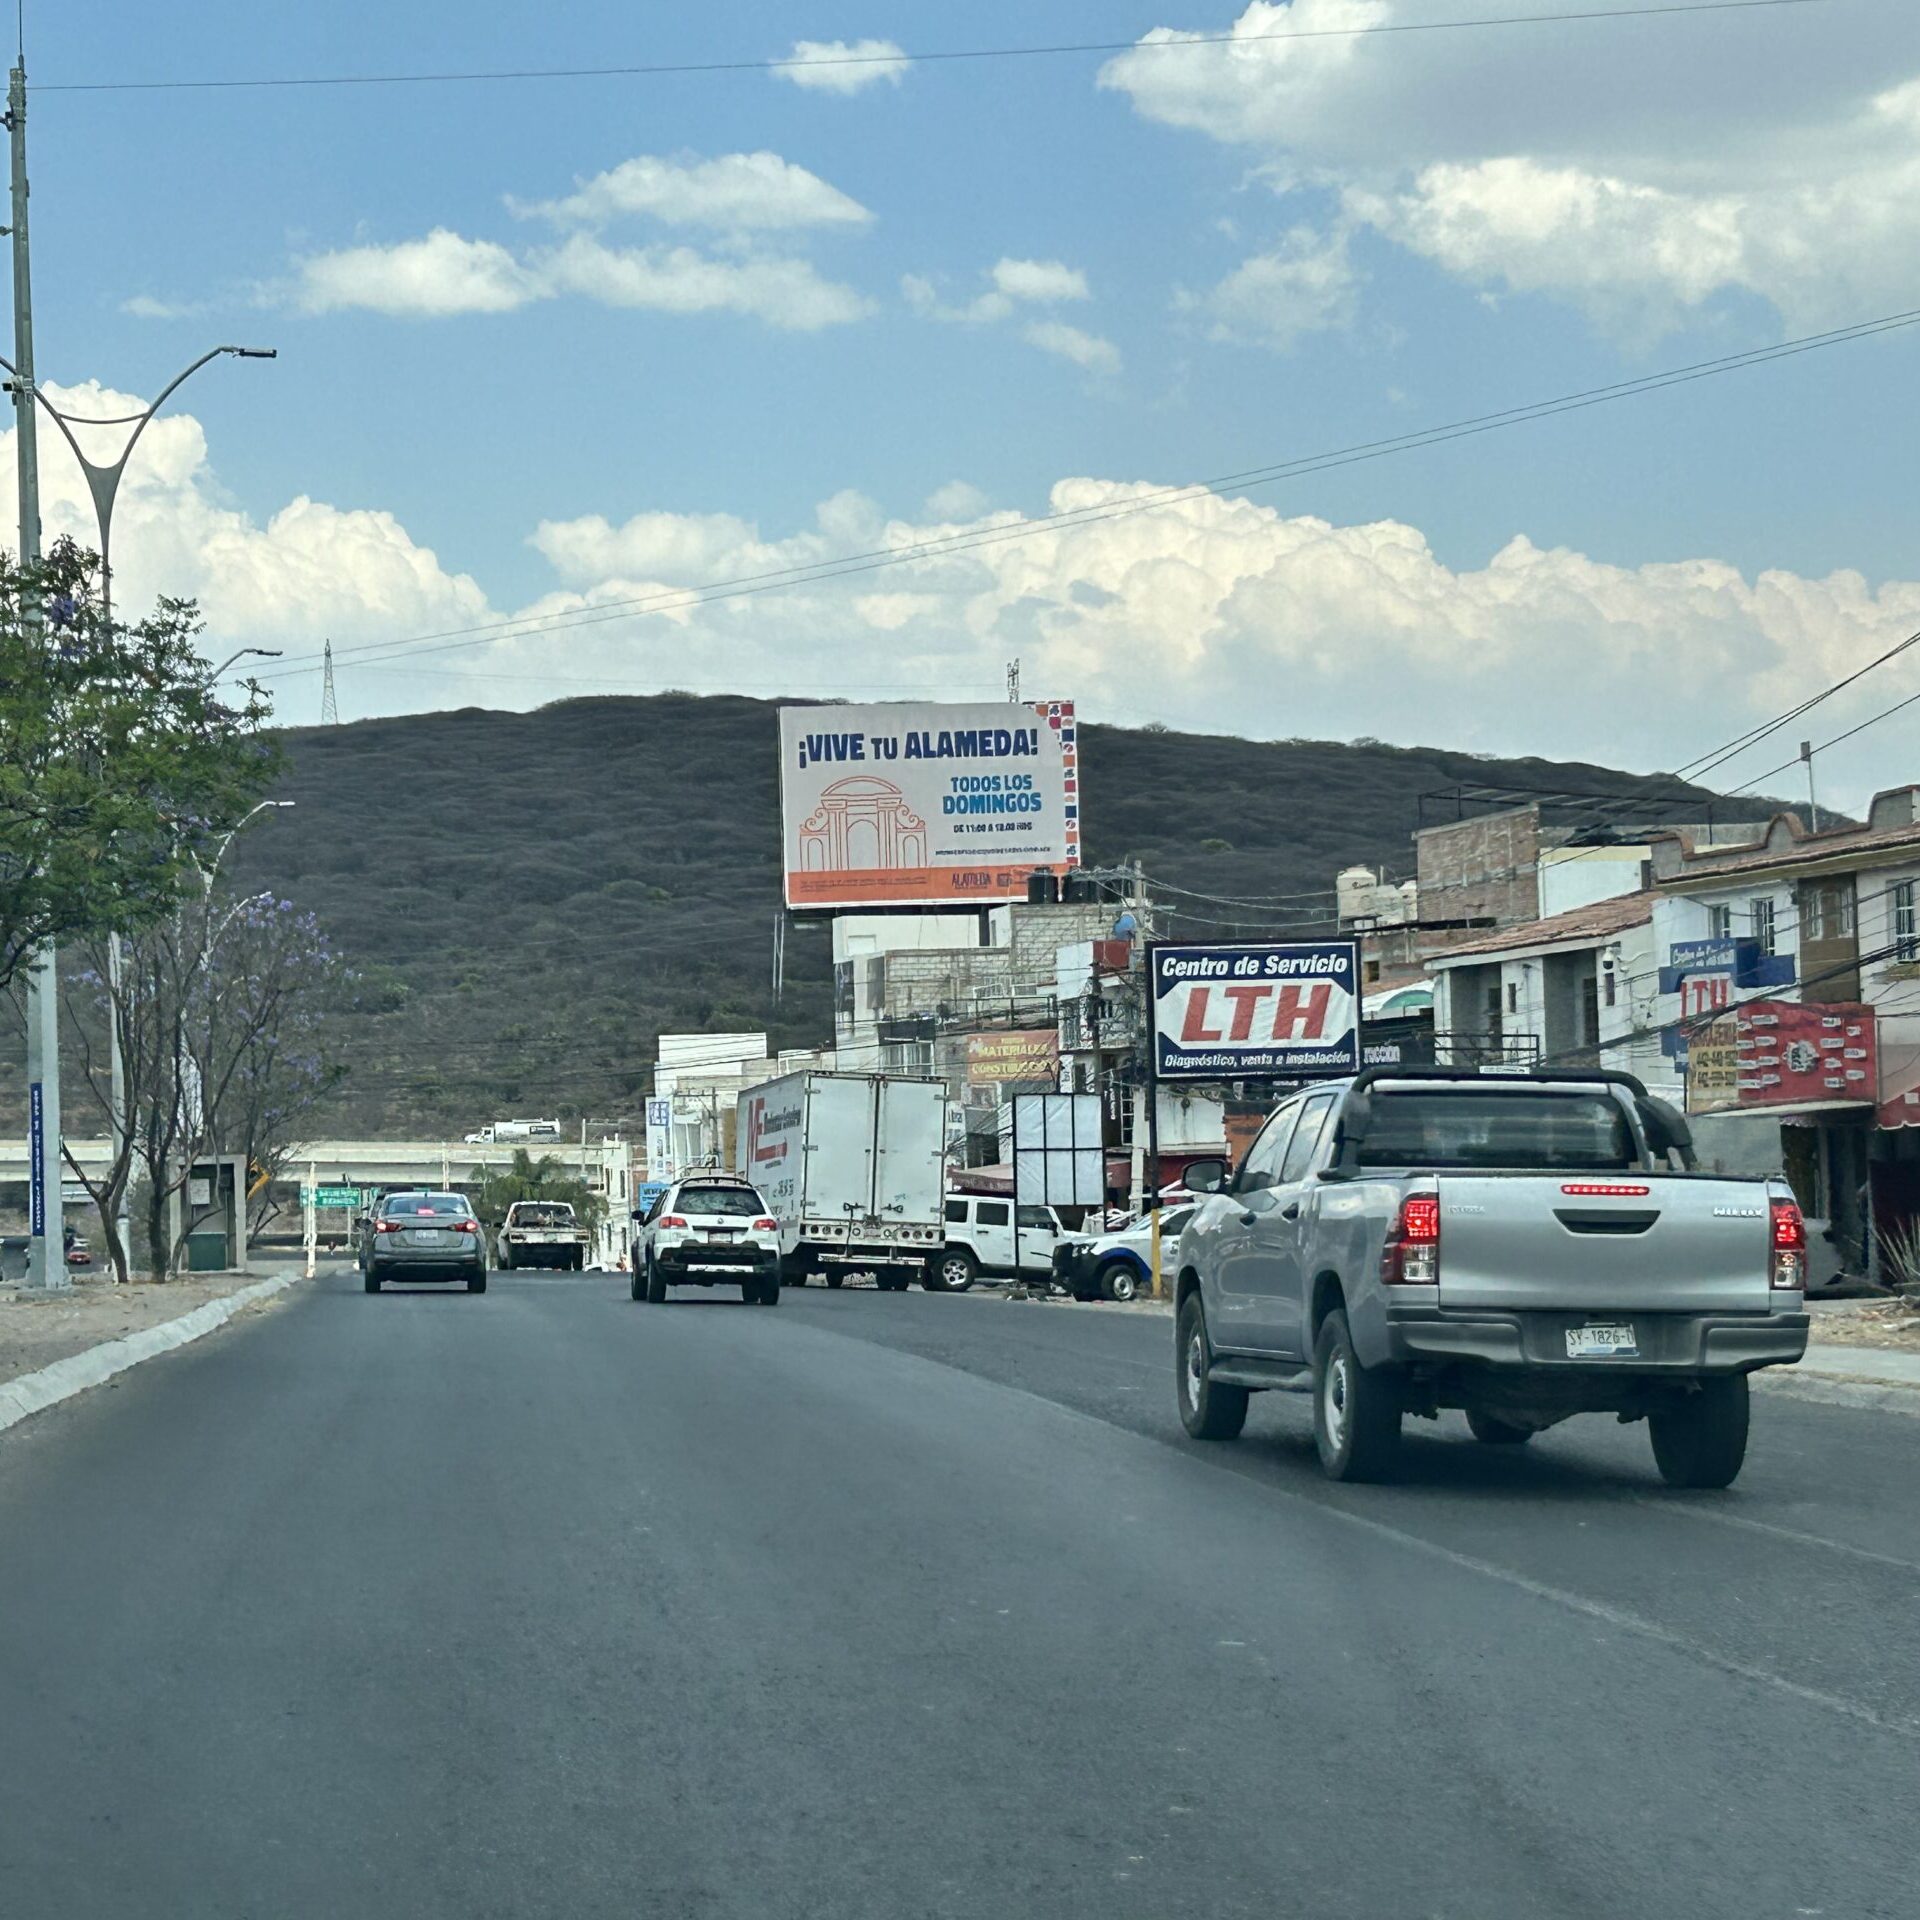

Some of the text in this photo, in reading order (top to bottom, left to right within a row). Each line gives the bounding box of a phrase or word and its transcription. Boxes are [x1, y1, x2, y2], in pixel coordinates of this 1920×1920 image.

[799, 728, 1039, 769] ¡VIVE TU ALAMEDA!
[950, 774, 1032, 793] TODOS LOS
[942, 792, 1042, 815] DOMINGOS
[953, 824, 964, 833] DE
[1161, 953, 1348, 977] Centro de Servicio
[1180, 983, 1332, 1042] LTH
[1164, 1053, 1238, 1069] Diagnóstico,
[1240, 1054, 1273, 1067] venta
[1275, 1054, 1283, 1066] e
[1285, 1050, 1351, 1066] instalación
